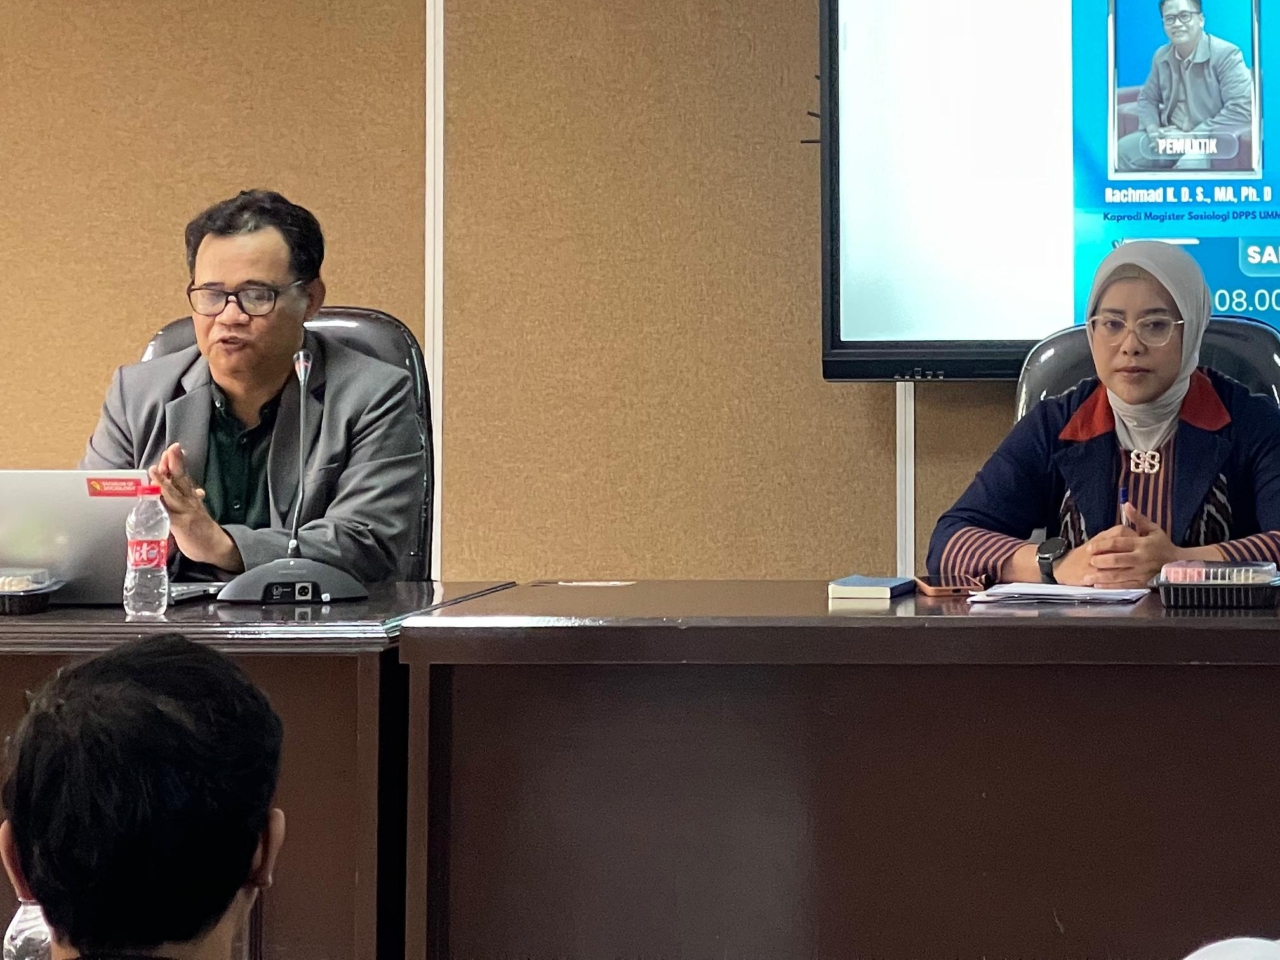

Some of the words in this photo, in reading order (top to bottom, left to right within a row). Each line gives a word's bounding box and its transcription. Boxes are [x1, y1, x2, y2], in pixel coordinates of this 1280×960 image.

[1104, 186, 1164, 203] Rachmad
[1180, 185, 1193, 202] D.
[1195, 185, 1211, 204] S.,
[1213, 184, 1238, 204] MA,
[1240, 184, 1261, 202] Ph.
[1263, 185, 1272, 202] D
[1103, 210, 1142, 223] Kaprodi
[1143, 211, 1186, 223] Magister
[1187, 210, 1230, 222] Sosiologi
[1231, 210, 1258, 220] DPPS
